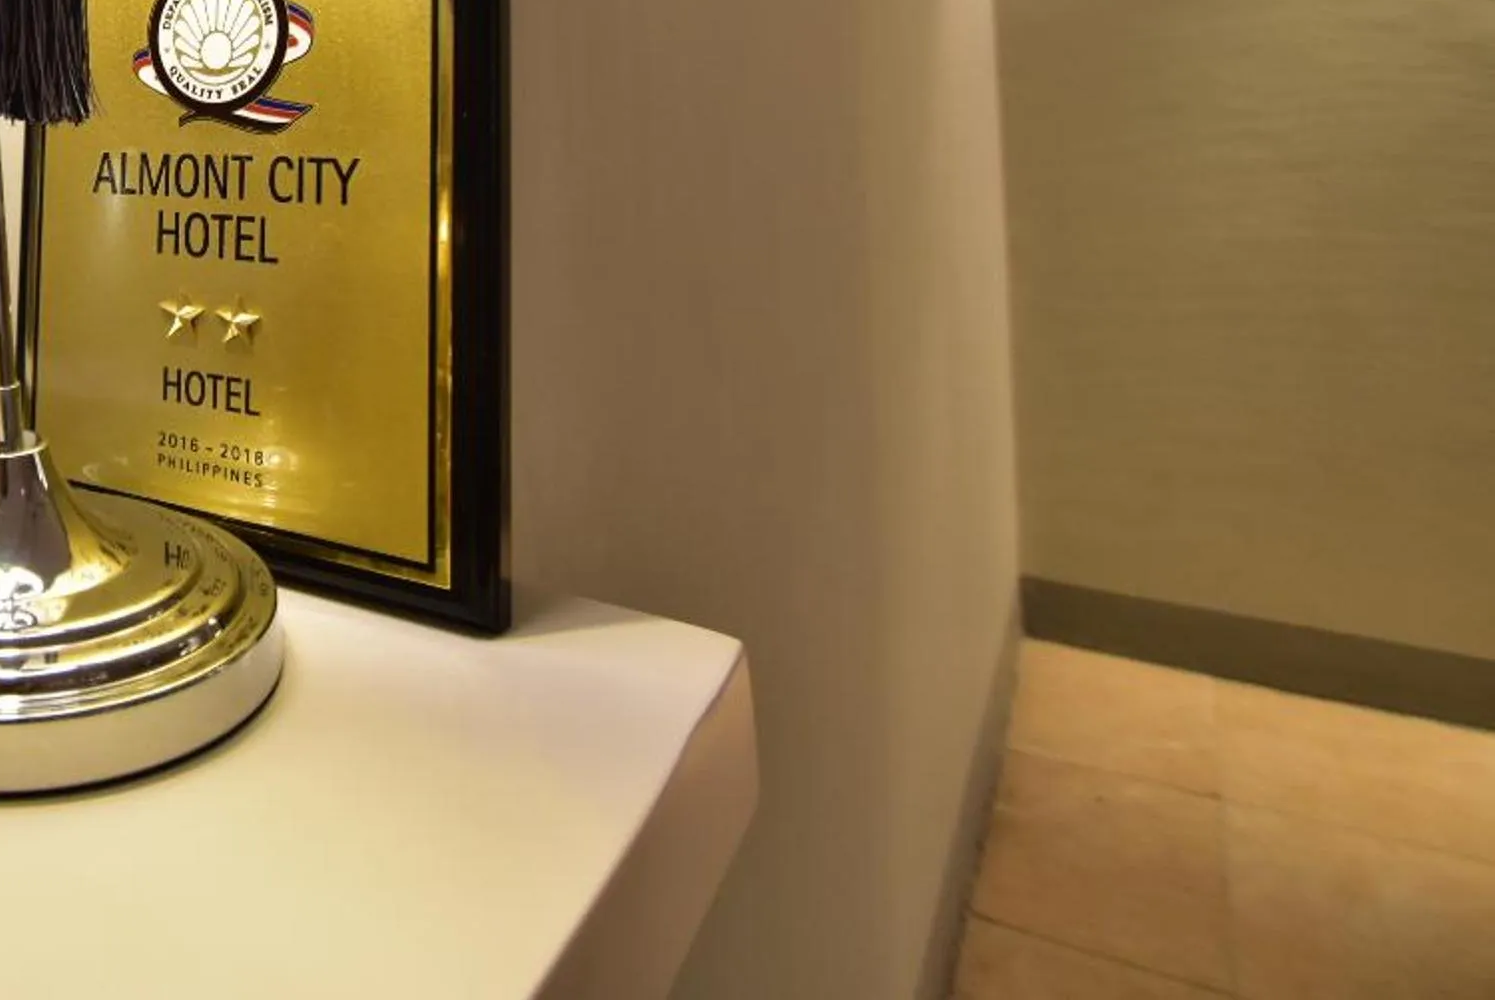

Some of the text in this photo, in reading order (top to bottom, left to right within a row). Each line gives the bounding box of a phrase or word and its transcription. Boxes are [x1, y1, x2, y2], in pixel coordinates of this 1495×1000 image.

[170, 65, 263, 99] QUALITY SEAL
[92, 151, 362, 206] ALMONT CITY
[156, 210, 279, 265] HOTEL
[162, 366, 261, 417] HOTEL
[157, 431, 199, 452] 2016
[219, 443, 264, 466] 2018
[157, 453, 264, 488] PHILIPPINES
